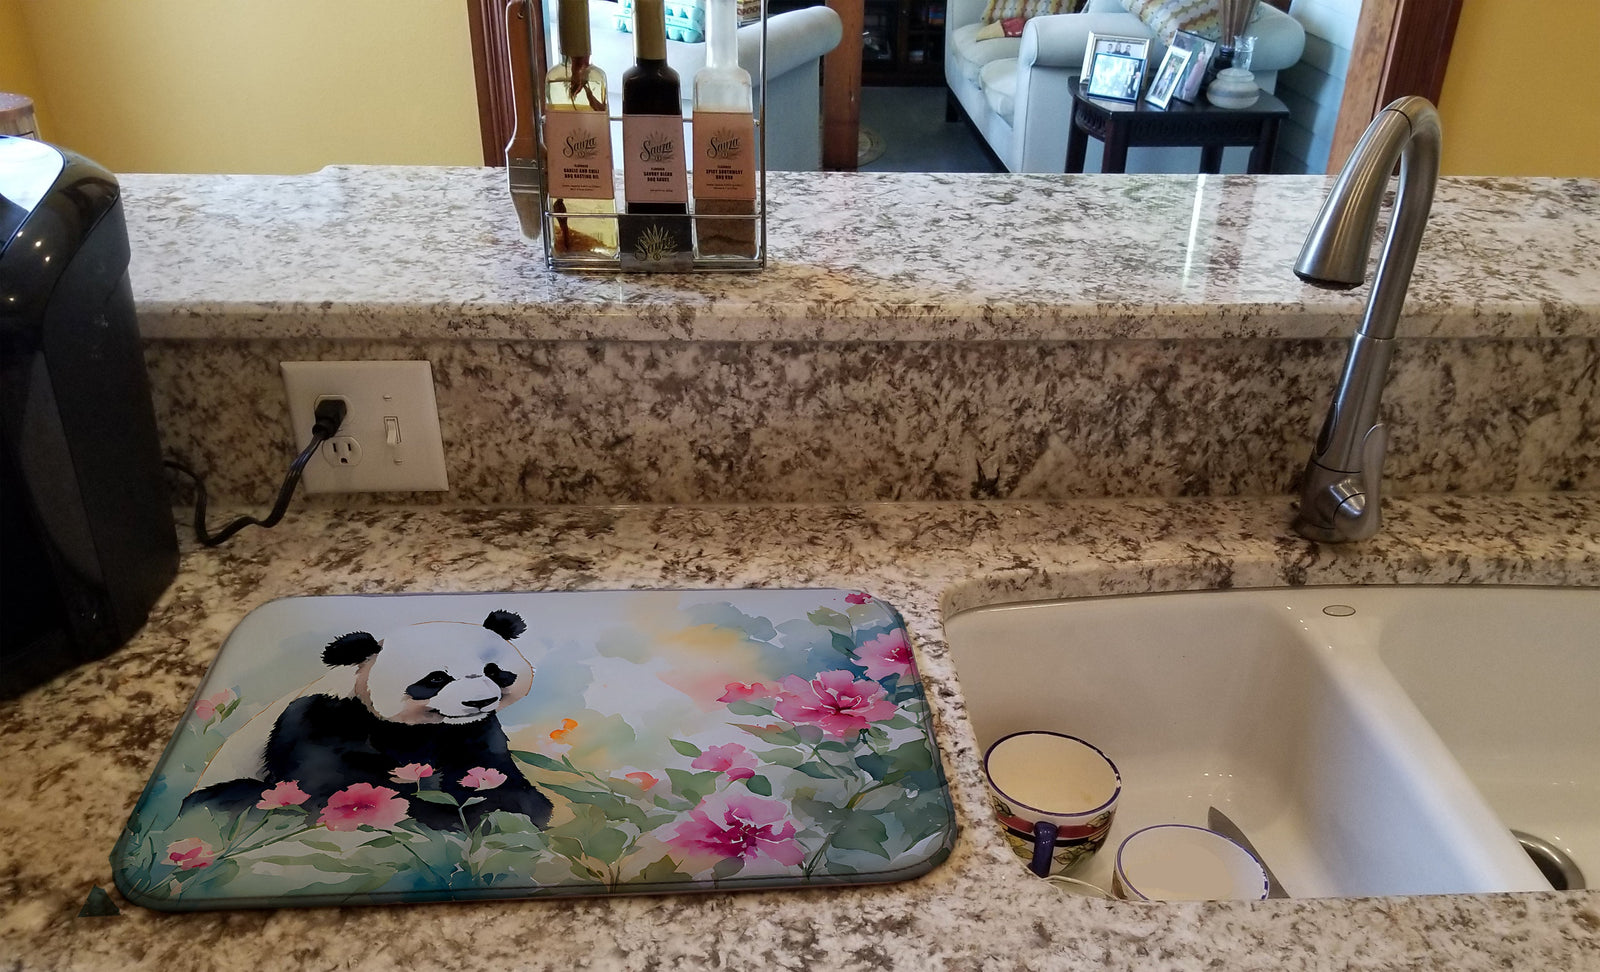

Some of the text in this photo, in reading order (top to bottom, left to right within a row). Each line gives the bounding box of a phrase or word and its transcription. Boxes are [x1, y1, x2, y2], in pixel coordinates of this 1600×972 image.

[562, 136, 597, 158] Sauza
[640, 140, 674, 162] Sauza
[707, 136, 740, 159] Sauza
